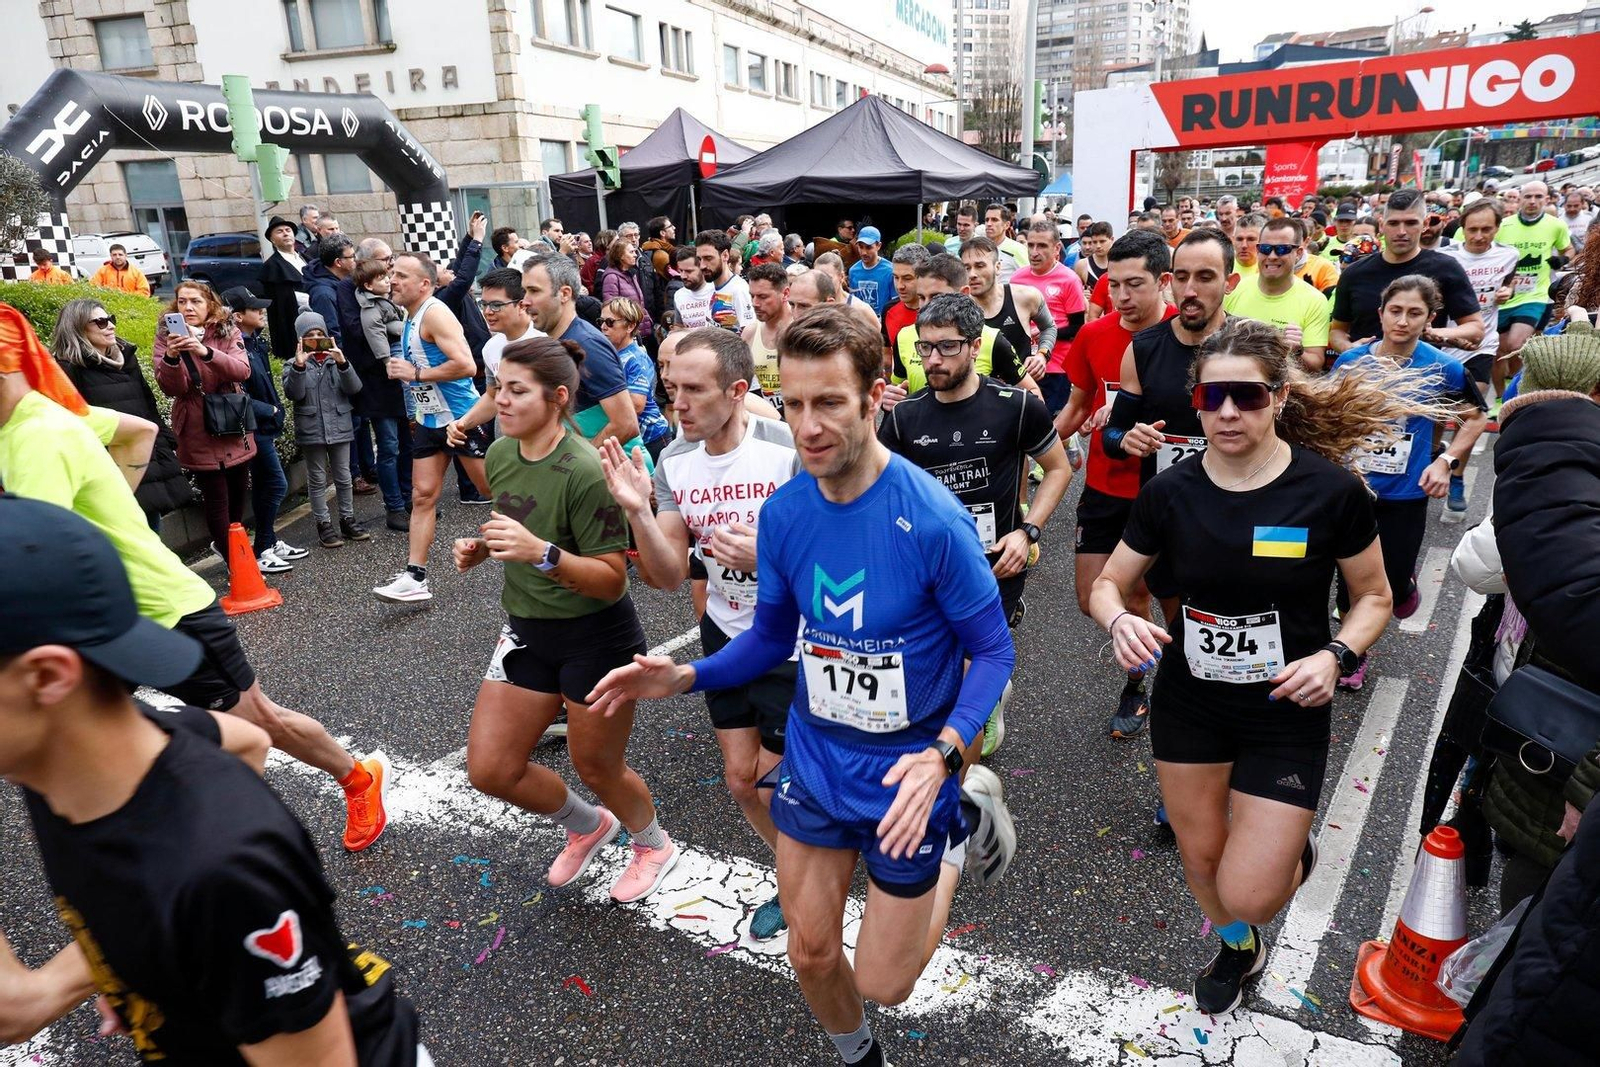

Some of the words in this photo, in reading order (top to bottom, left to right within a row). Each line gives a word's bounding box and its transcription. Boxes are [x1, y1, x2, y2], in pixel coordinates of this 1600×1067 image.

[176, 99, 334, 137] ROOSA
[385, 119, 442, 180] ALPINE
[1270, 174, 1309, 184] Santander
[1273, 162, 1298, 172] Sports
[959, 467, 991, 481] TRAIL
[690, 482, 778, 505] CARREIRA
[1198, 627, 1258, 657] 324
[822, 664, 879, 701] 179
